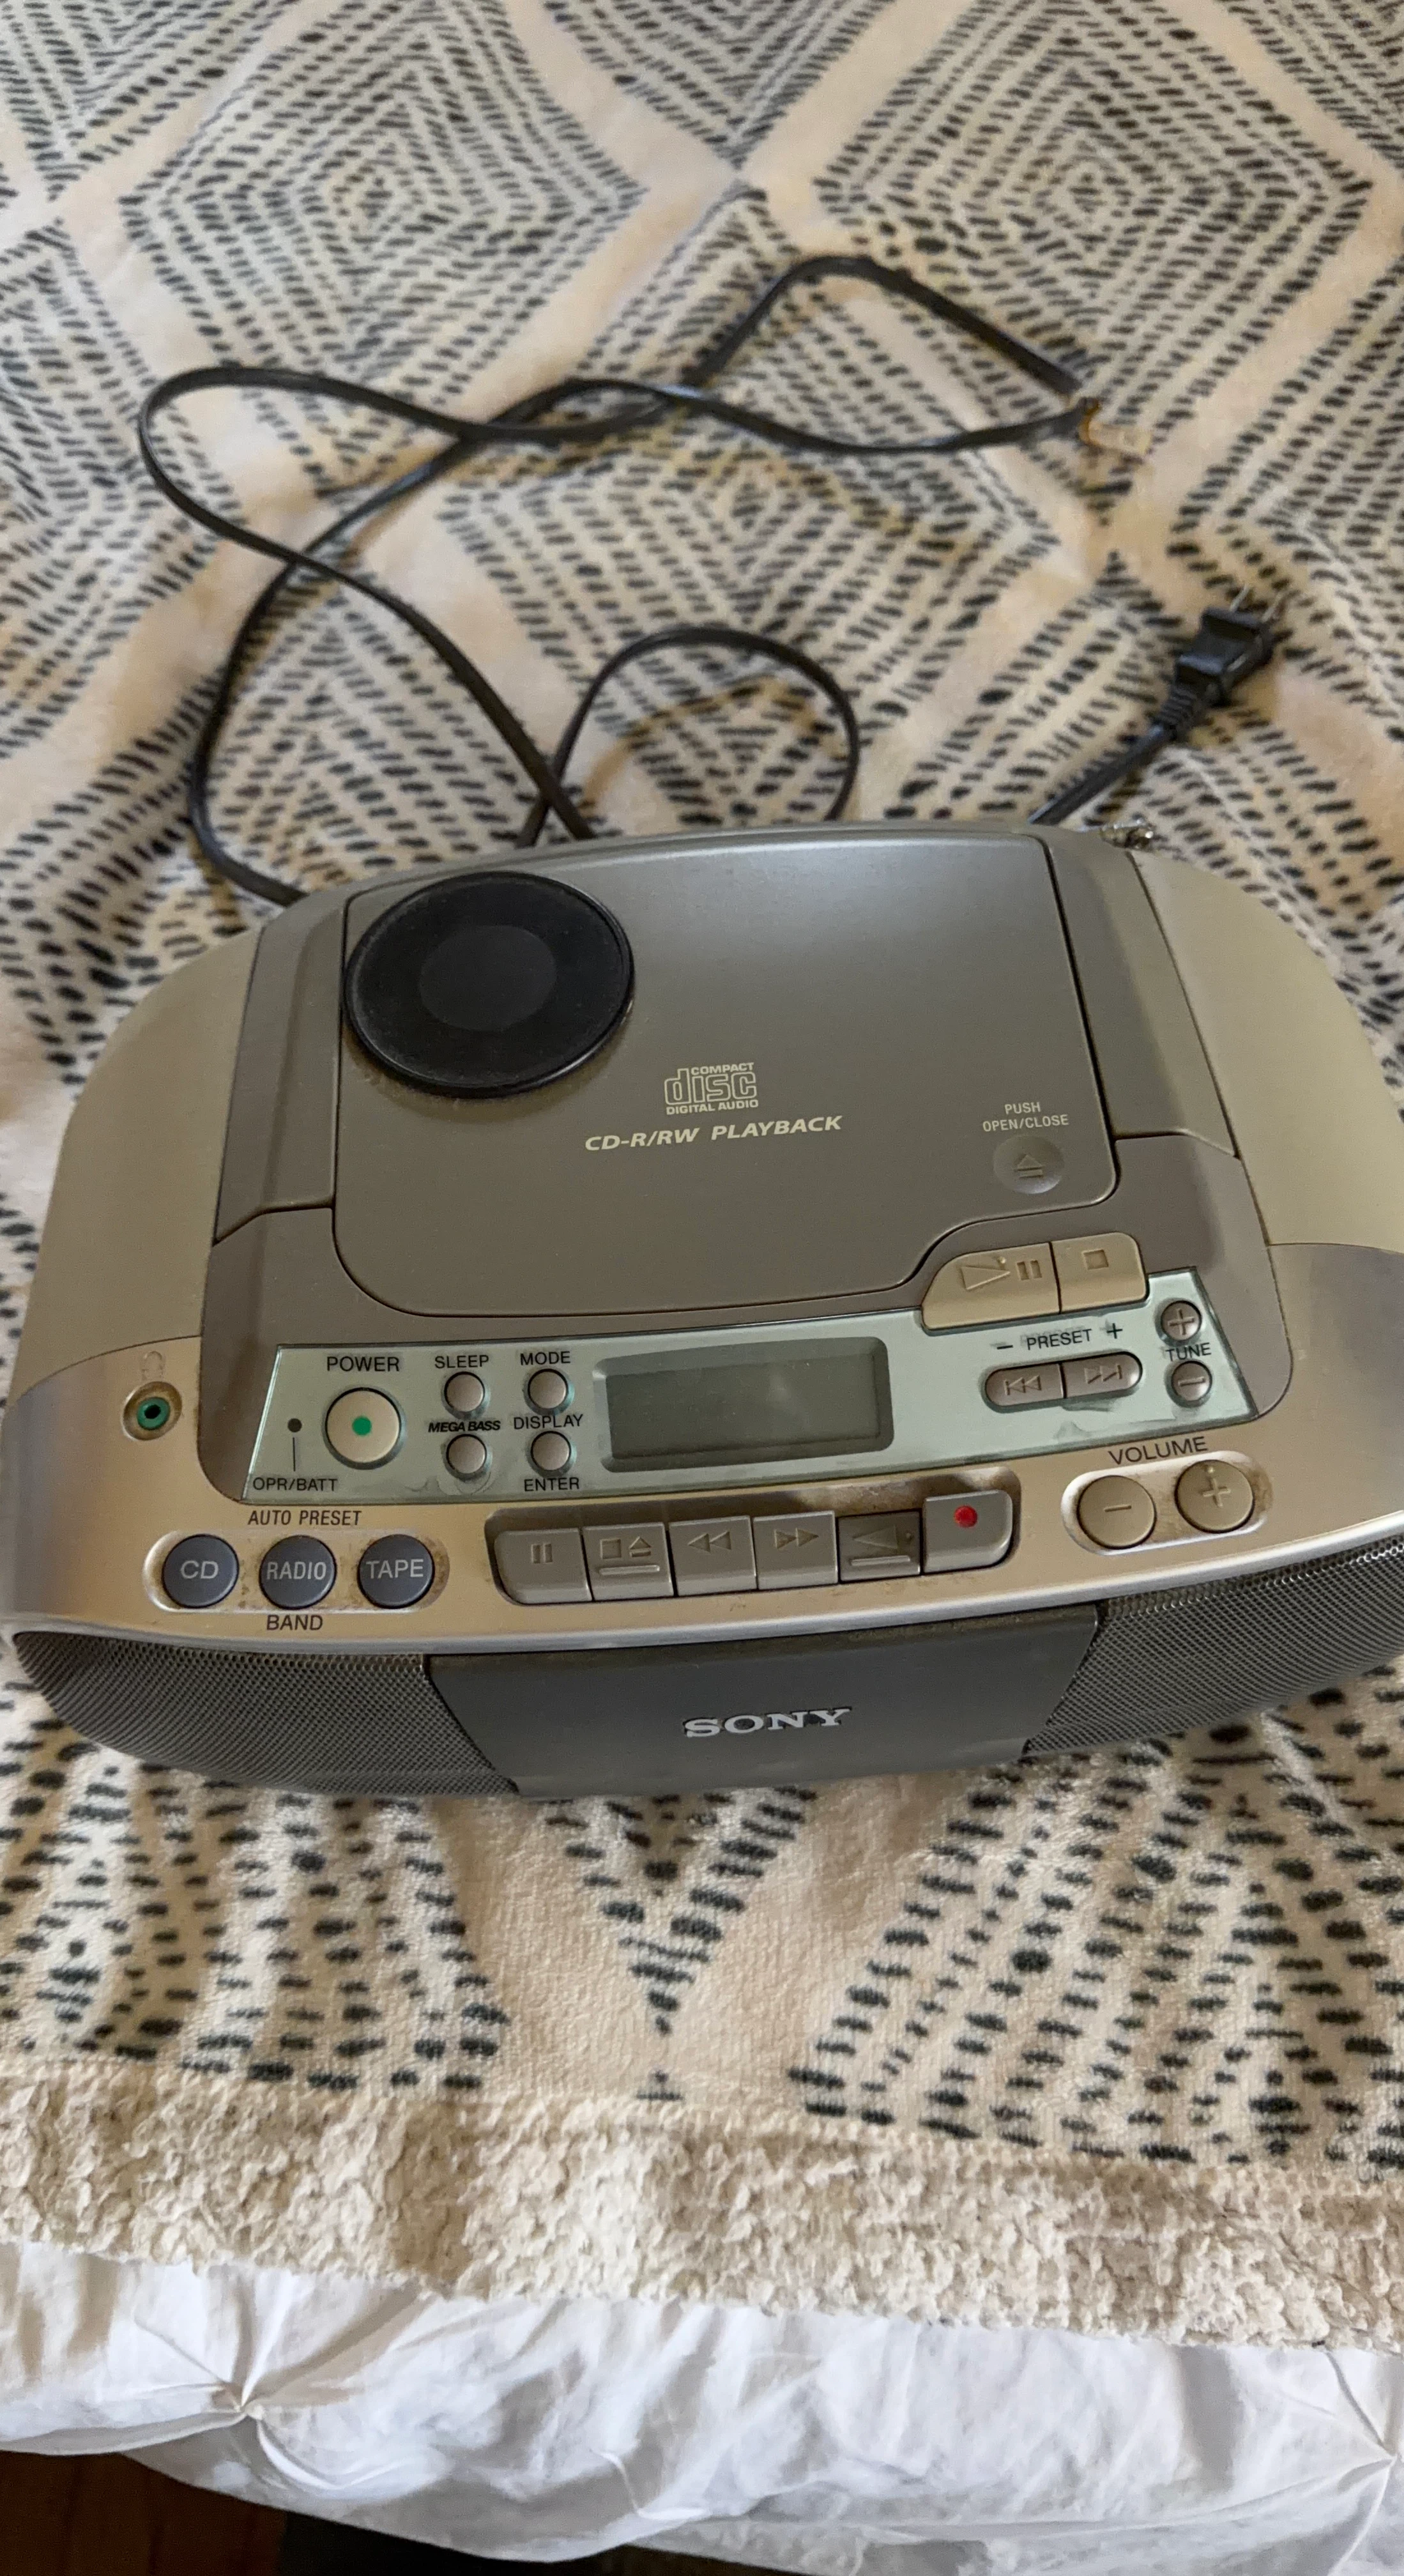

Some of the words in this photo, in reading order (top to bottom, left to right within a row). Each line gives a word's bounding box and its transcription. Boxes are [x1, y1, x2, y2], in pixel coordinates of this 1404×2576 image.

[691, 1062, 754, 1075] COMPACT
[666, 1103, 715, 1116] DIGITAL
[717, 1099, 759, 1110] AUDIO
[1005, 1102, 1041, 1114] PUSH
[982, 1115, 1069, 1132] OPEN/CLOSE
[584, 1127, 699, 1151] CD-R/RW
[711, 1115, 843, 1140] PLAYBACK
[1026, 1328, 1093, 1351] PRESET
[519, 1351, 571, 1366] MODE
[1166, 1342, 1212, 1360] TUNE
[326, 1356, 400, 1372] POWER
[434, 1354, 490, 1368] SLEEP
[428, 1422, 466, 1433] MEGA
[468, 1420, 501, 1432] BASS
[513, 1414, 583, 1430] DISPLAY
[1108, 1436, 1209, 1466] VOLUME
[252, 1478, 338, 1492] OPR/BATT
[523, 1477, 580, 1492] ENTER
[247, 1510, 292, 1526] AUTO
[298, 1510, 362, 1526] PRESET
[179, 1560, 219, 1579] CD
[266, 1562, 327, 1581] RADIO
[365, 1559, 424, 1579] TAPE
[266, 1614, 323, 1631] BAND
[683, 1706, 850, 1738] SONY
